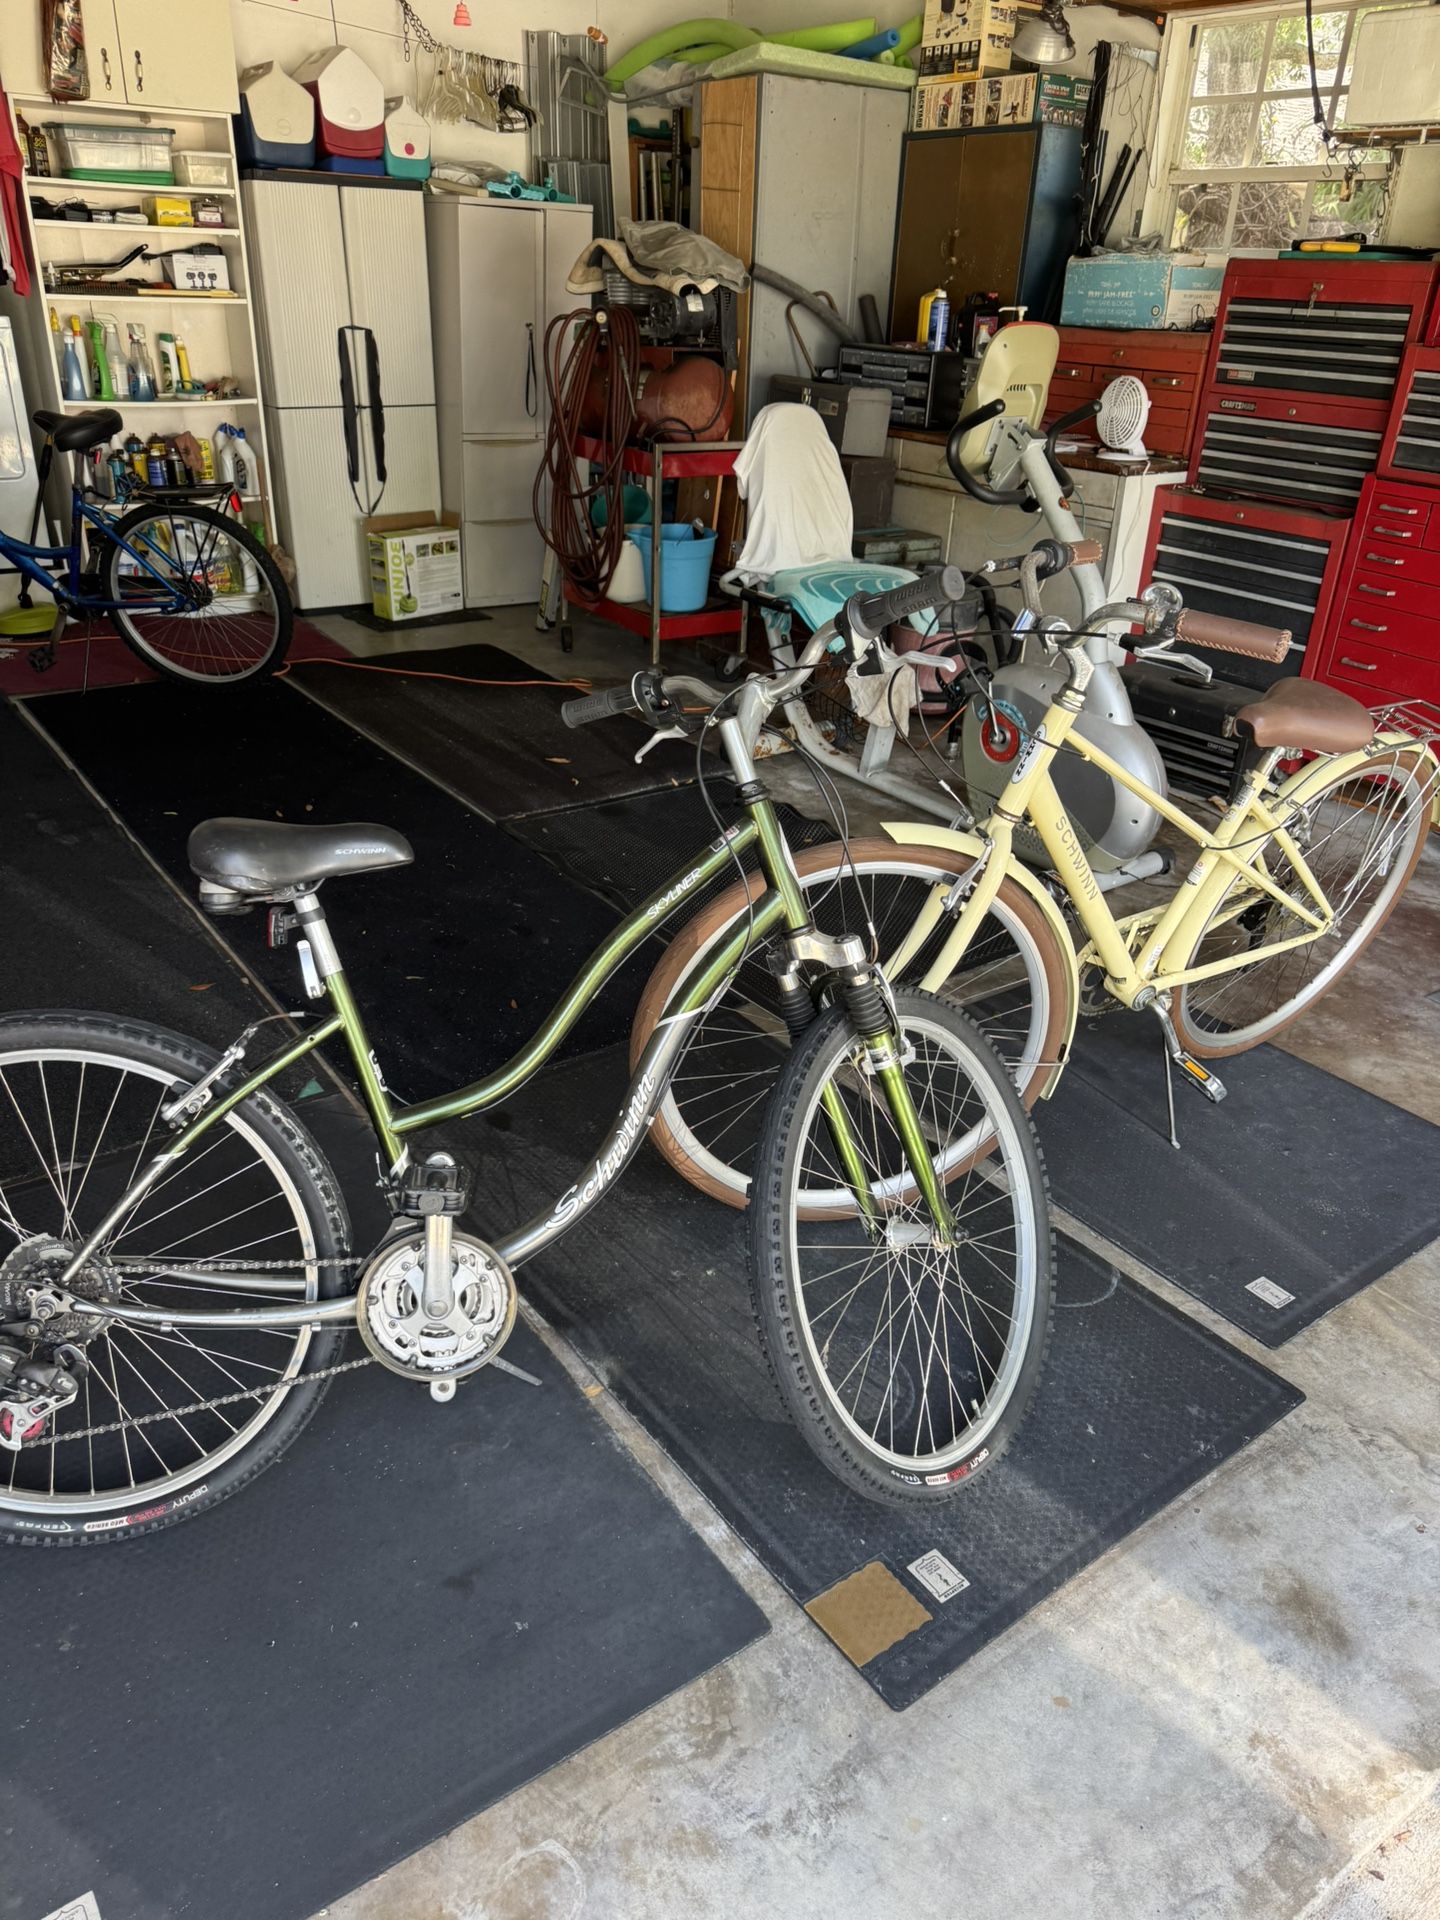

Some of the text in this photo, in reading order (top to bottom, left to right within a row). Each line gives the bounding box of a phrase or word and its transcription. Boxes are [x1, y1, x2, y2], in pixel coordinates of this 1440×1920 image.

[335, 847, 386, 855] SCHWINN
[1055, 815, 1099, 901] SCHWINN
[647, 868, 702, 920] SKYLINER
[544, 1073, 655, 1229] Schwinn
[172, 1485, 208, 1509] DEPUTY
